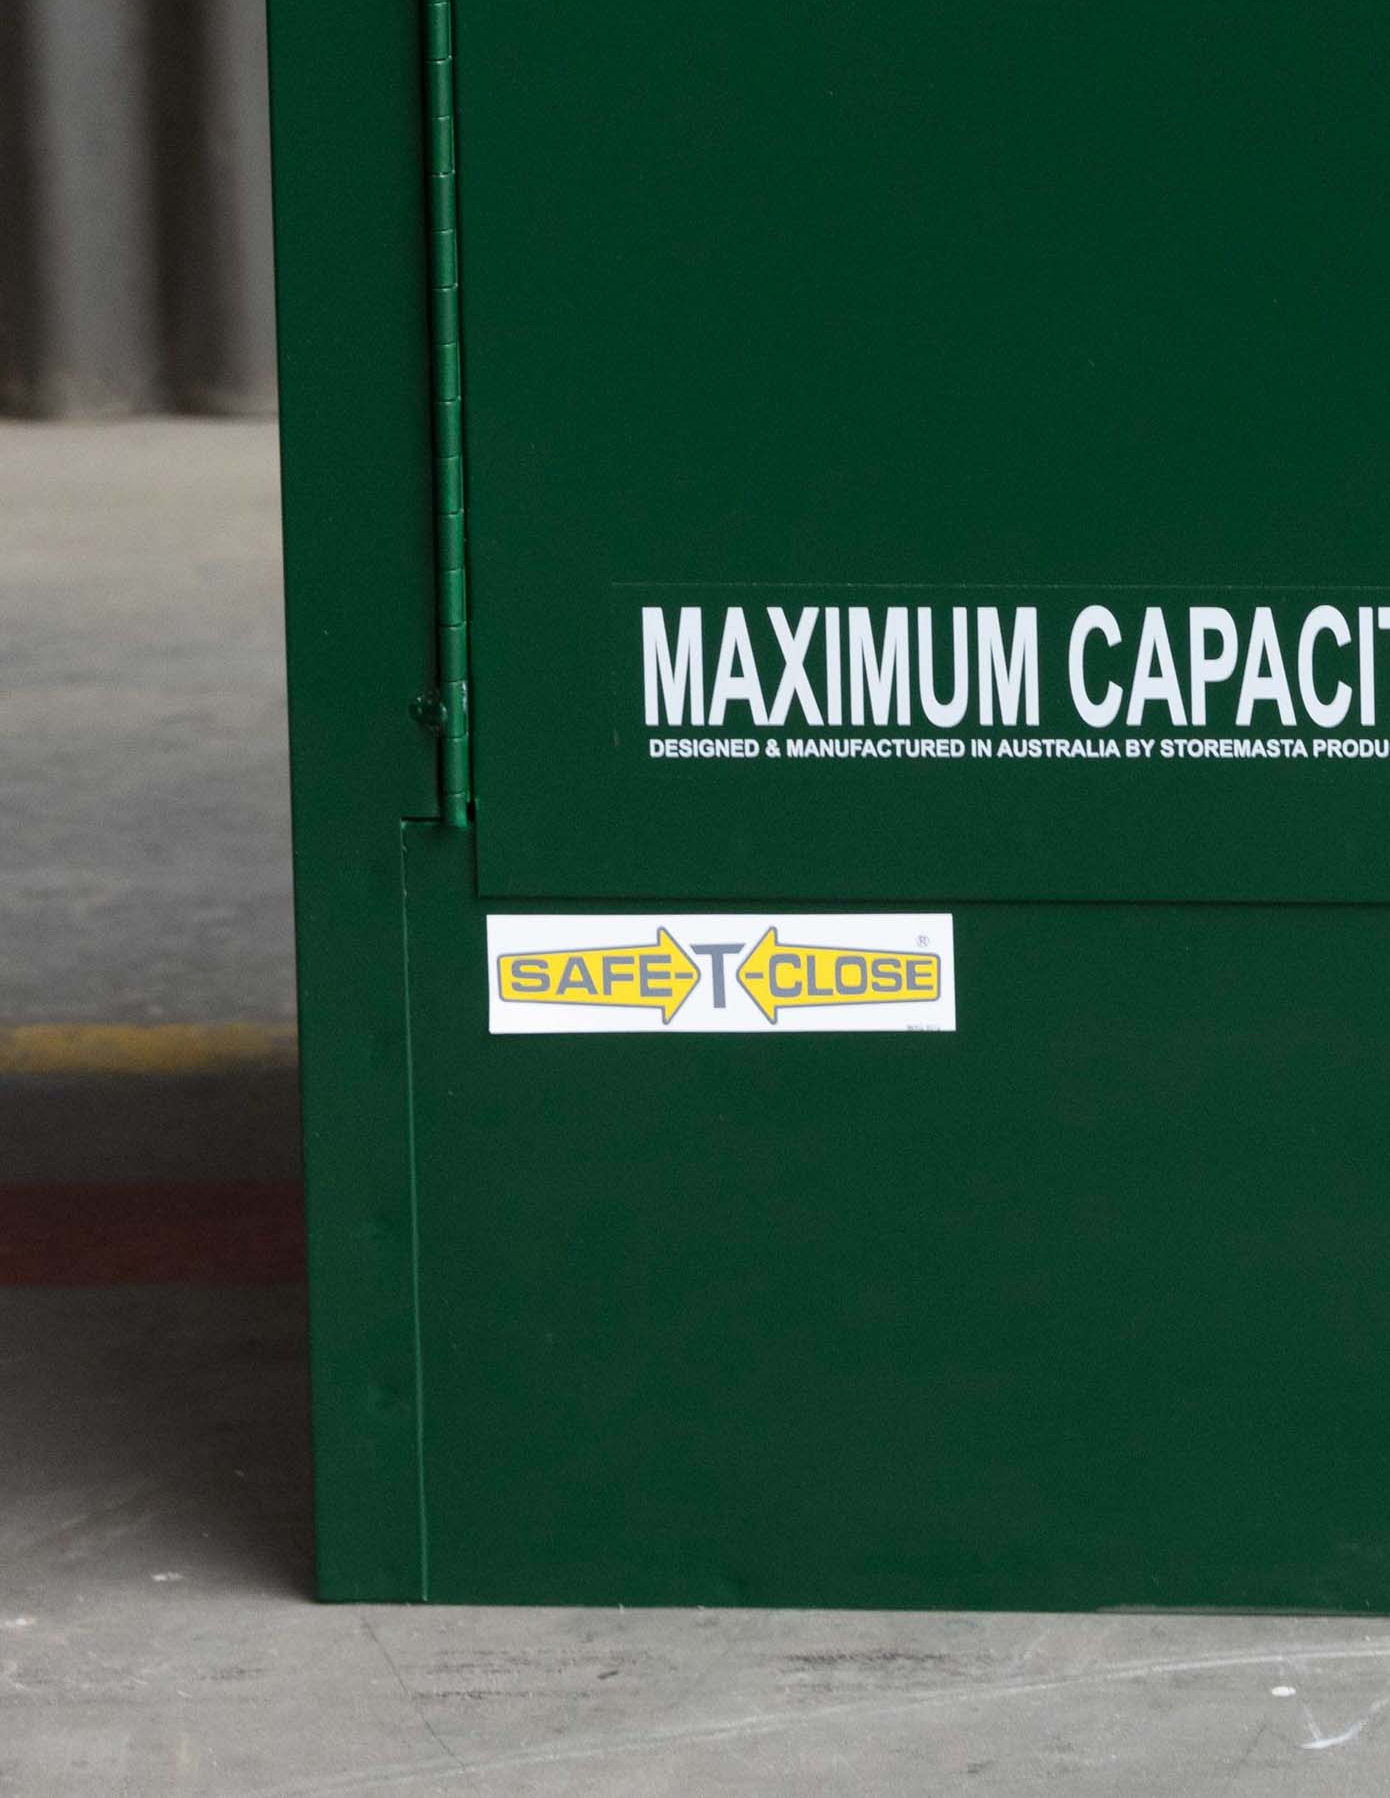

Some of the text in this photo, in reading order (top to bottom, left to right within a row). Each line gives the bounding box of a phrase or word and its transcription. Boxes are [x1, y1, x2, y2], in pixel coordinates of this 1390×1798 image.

[643, 607, 1039, 727] MAXIMUM
[649, 738, 760, 758] DESIGNED
[764, 738, 782, 758] &
[786, 738, 966, 758] MANUFACTURED
[970, 738, 993, 758] IN
[996, 738, 1121, 758] AUSTRALIA
[1125, 738, 1156, 758] BY
[1159, 738, 1309, 758] STOREMASTA
